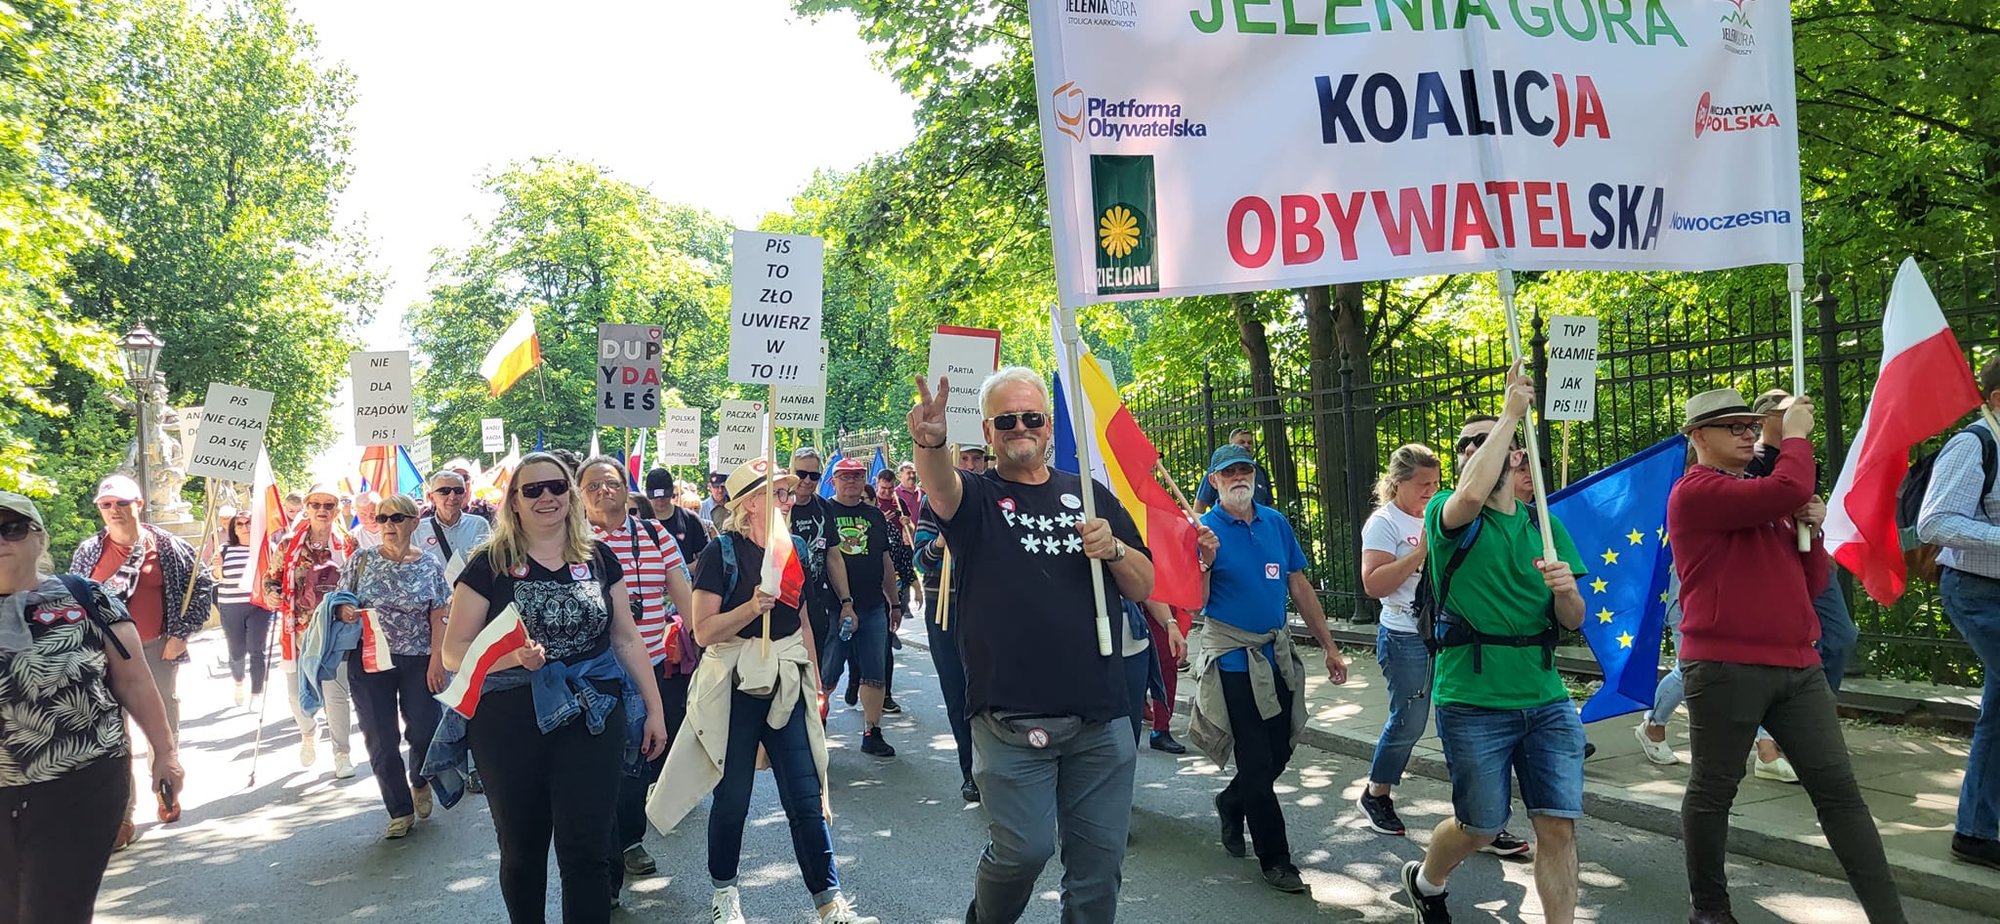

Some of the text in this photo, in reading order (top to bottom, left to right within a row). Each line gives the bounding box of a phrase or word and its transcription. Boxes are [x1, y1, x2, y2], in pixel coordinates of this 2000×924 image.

[1088, 98, 1181, 118] Platforma
[1314, 69, 1610, 148] KOALICJA
[1706, 112, 1780, 132] POLSKA
[1088, 118, 1207, 142] Obywatelska
[1226, 180, 1664, 268] OBYWATELSKA
[1669, 210, 1790, 231] Nowoczesna
[766, 238, 791, 254] PiS
[766, 264, 789, 278] TO
[1097, 266, 1152, 288] ZIELONI
[760, 289, 792, 304] ZŁO
[742, 312, 810, 330] UWIERZ
[1564, 324, 1586, 337] TVP
[602, 340, 660, 360] DUP
[766, 340, 785, 354] W
[1550, 346, 1596, 360] KŁAMIE
[370, 358, 389, 368] NIE
[600, 366, 660, 386] YDA
[750, 364, 798, 380] TO !!!
[370, 382, 392, 392] DLA
[1560, 377, 1582, 390] JAK
[230, 396, 248, 406] PiS
[604, 388, 655, 410] ŁEŚ
[780, 394, 814, 404] HAŃBA
[1552, 400, 1587, 412] PiS !!!
[357, 404, 408, 418] RZĄDÓW
[726, 410, 756, 419] PACZKA
[774, 412, 820, 422] ZOSTANIE
[204, 413, 262, 430] NIE CIĄŻA
[726, 425, 755, 433] KACZKI
[372, 430, 388, 439] PiS
[209, 436, 248, 451] DA SIĘ
[194, 454, 247, 471] USUNĄĆ
